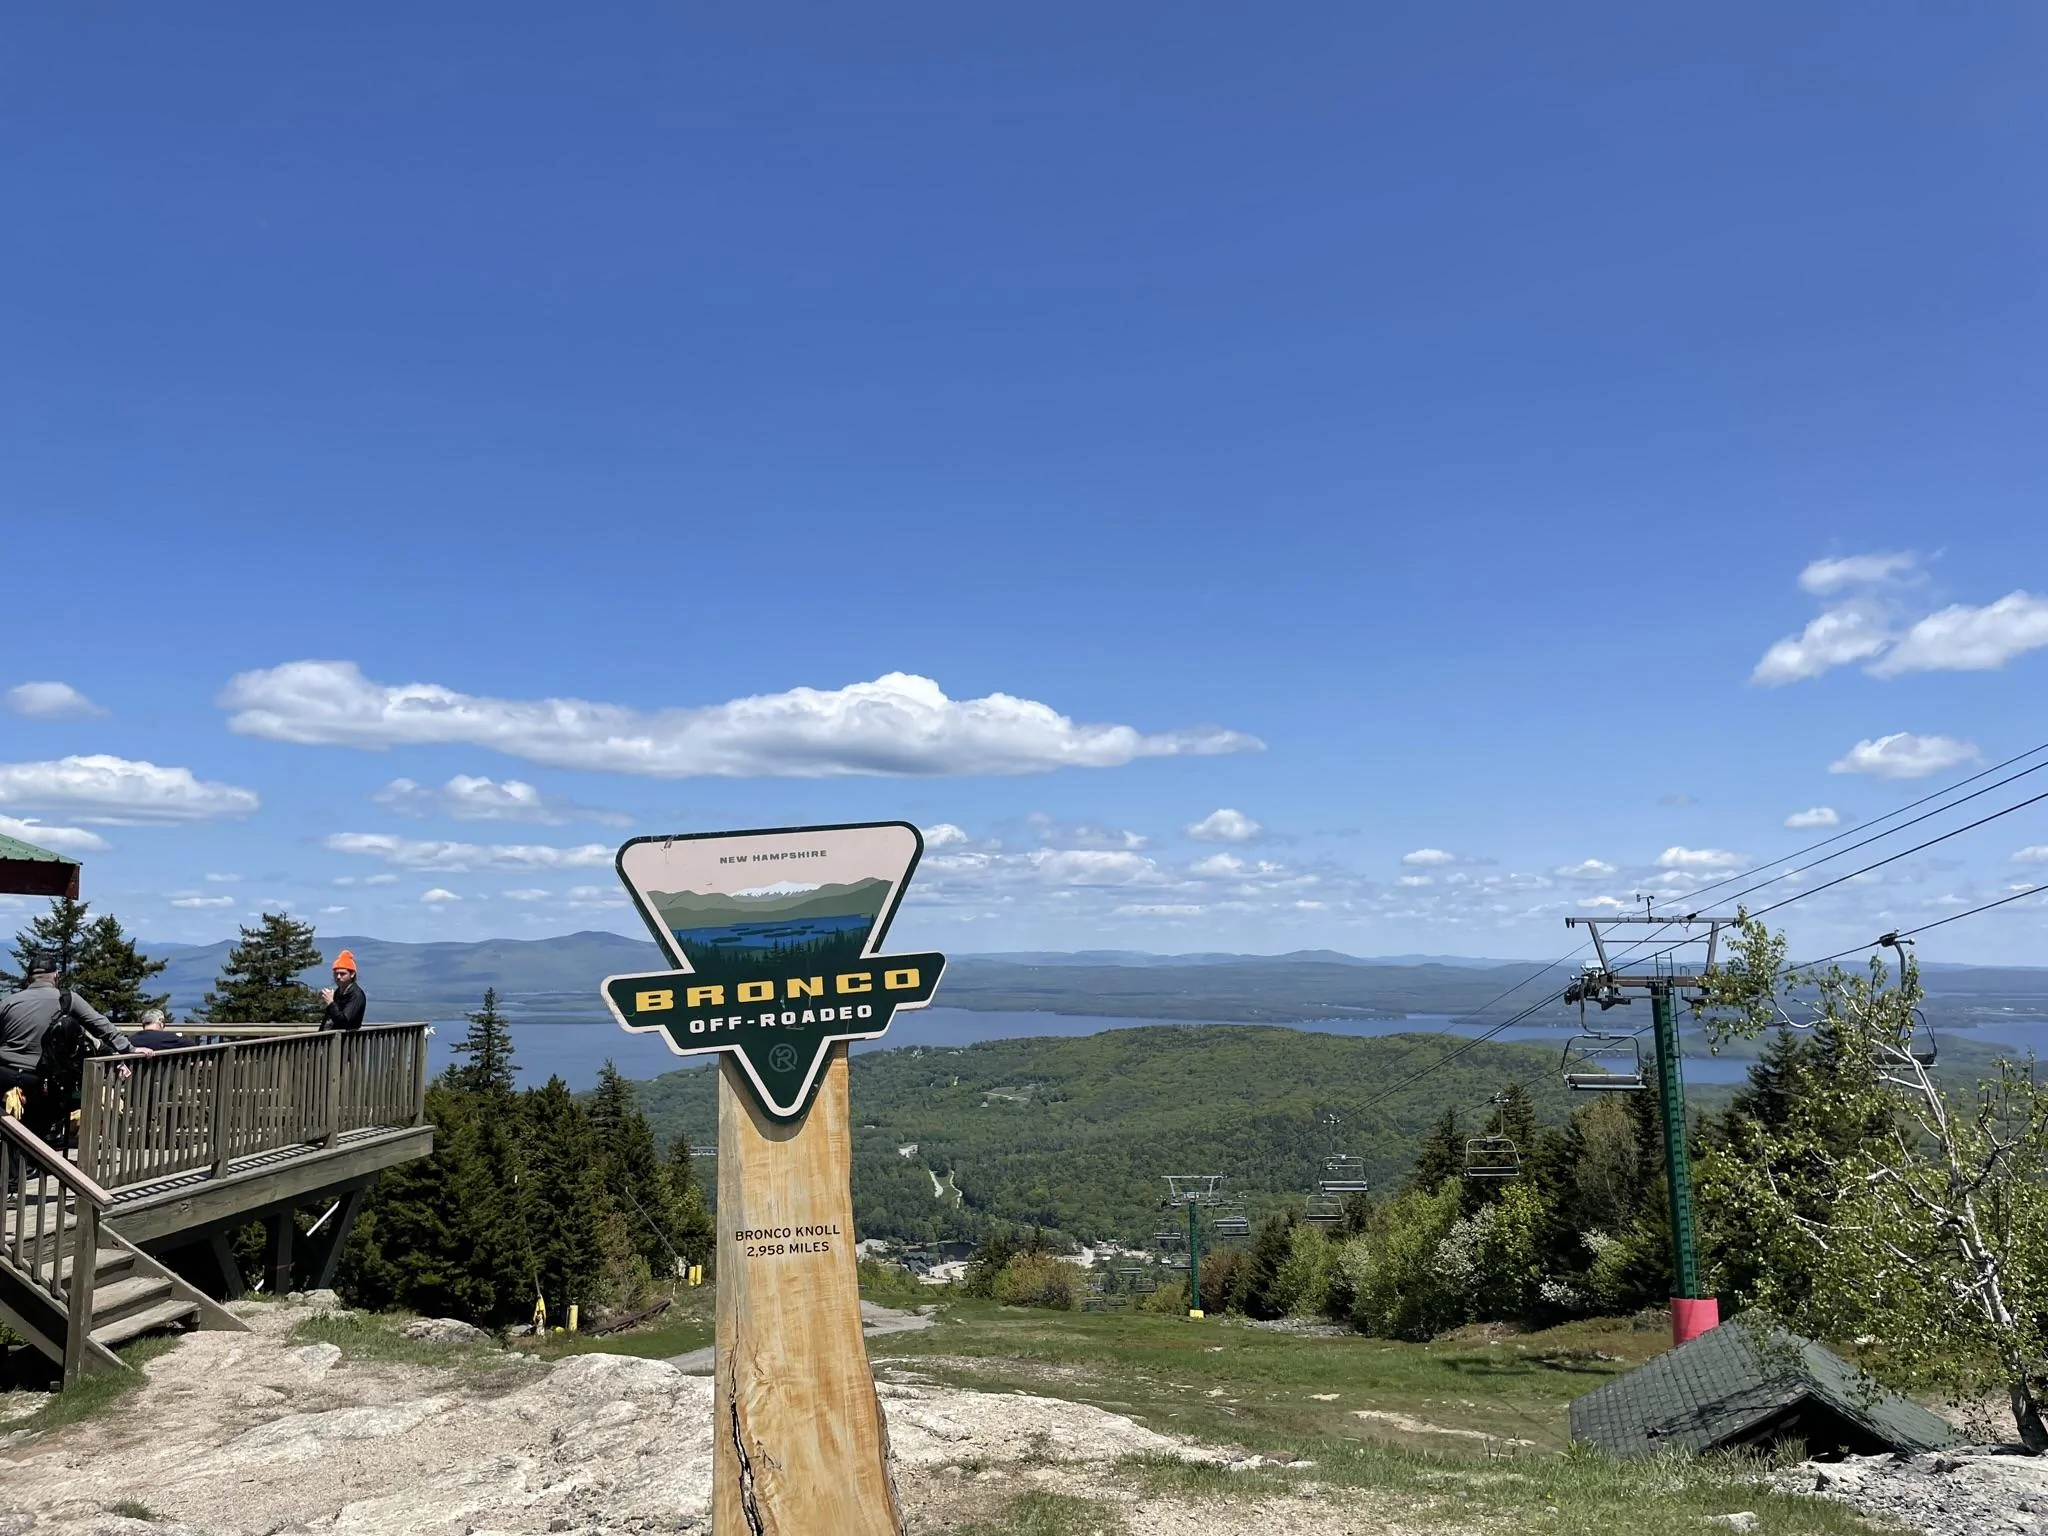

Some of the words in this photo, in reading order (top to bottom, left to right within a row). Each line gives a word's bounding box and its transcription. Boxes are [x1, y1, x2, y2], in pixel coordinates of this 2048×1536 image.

[720, 855, 748, 865] NEW
[752, 850, 827, 862] HAMPSHIRE
[635, 968, 920, 1012] BRONCO
[689, 1004, 872, 1034] OFF-ROADEO
[735, 1227, 791, 1241] BRONCO
[796, 1225, 840, 1237] KNOLL
[747, 1244, 785, 1257] 2,958
[789, 1241, 830, 1254] MILES
